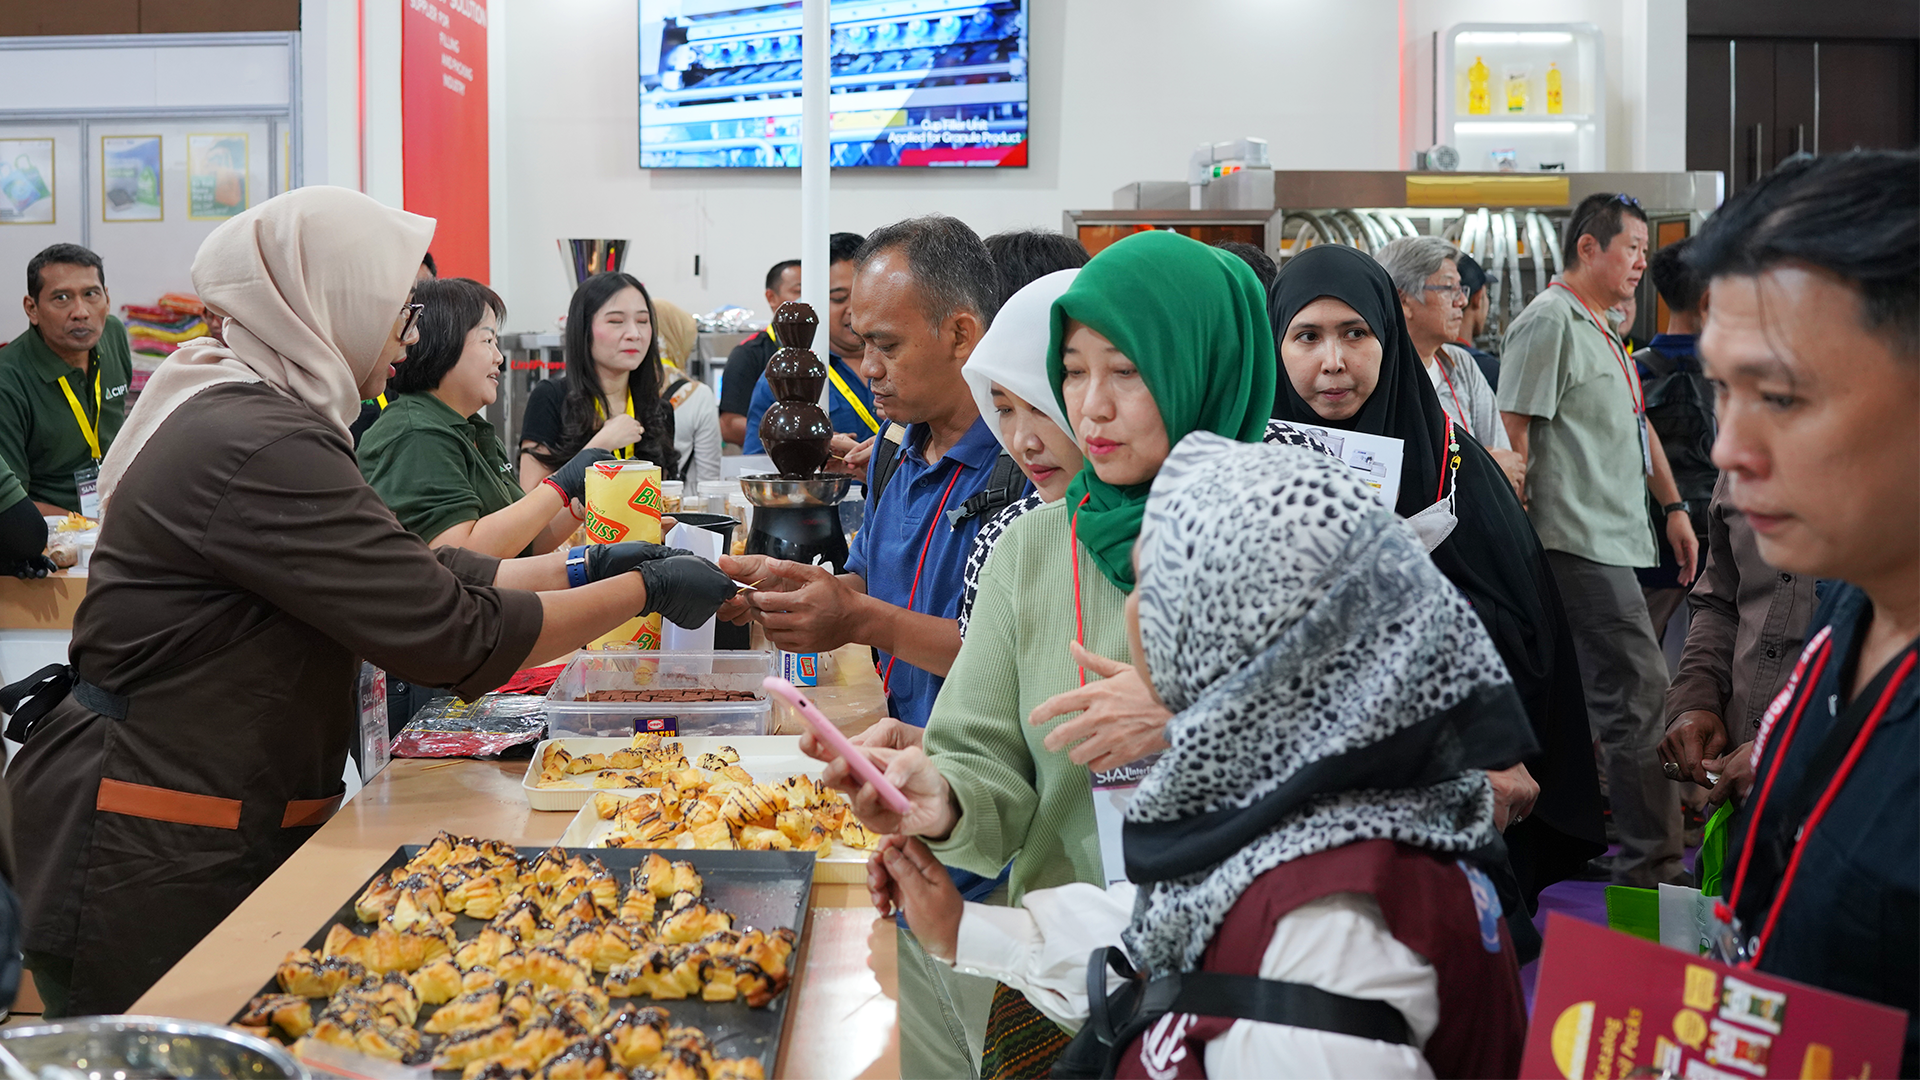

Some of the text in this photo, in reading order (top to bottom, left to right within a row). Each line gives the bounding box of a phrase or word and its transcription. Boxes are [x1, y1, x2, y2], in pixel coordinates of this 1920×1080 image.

[921, 119, 942, 132] Cup
[887, 131, 1022, 144] Applied for Granule Product
[586, 511, 620, 541] BLISS
[1095, 766, 1135, 784] SIAL
